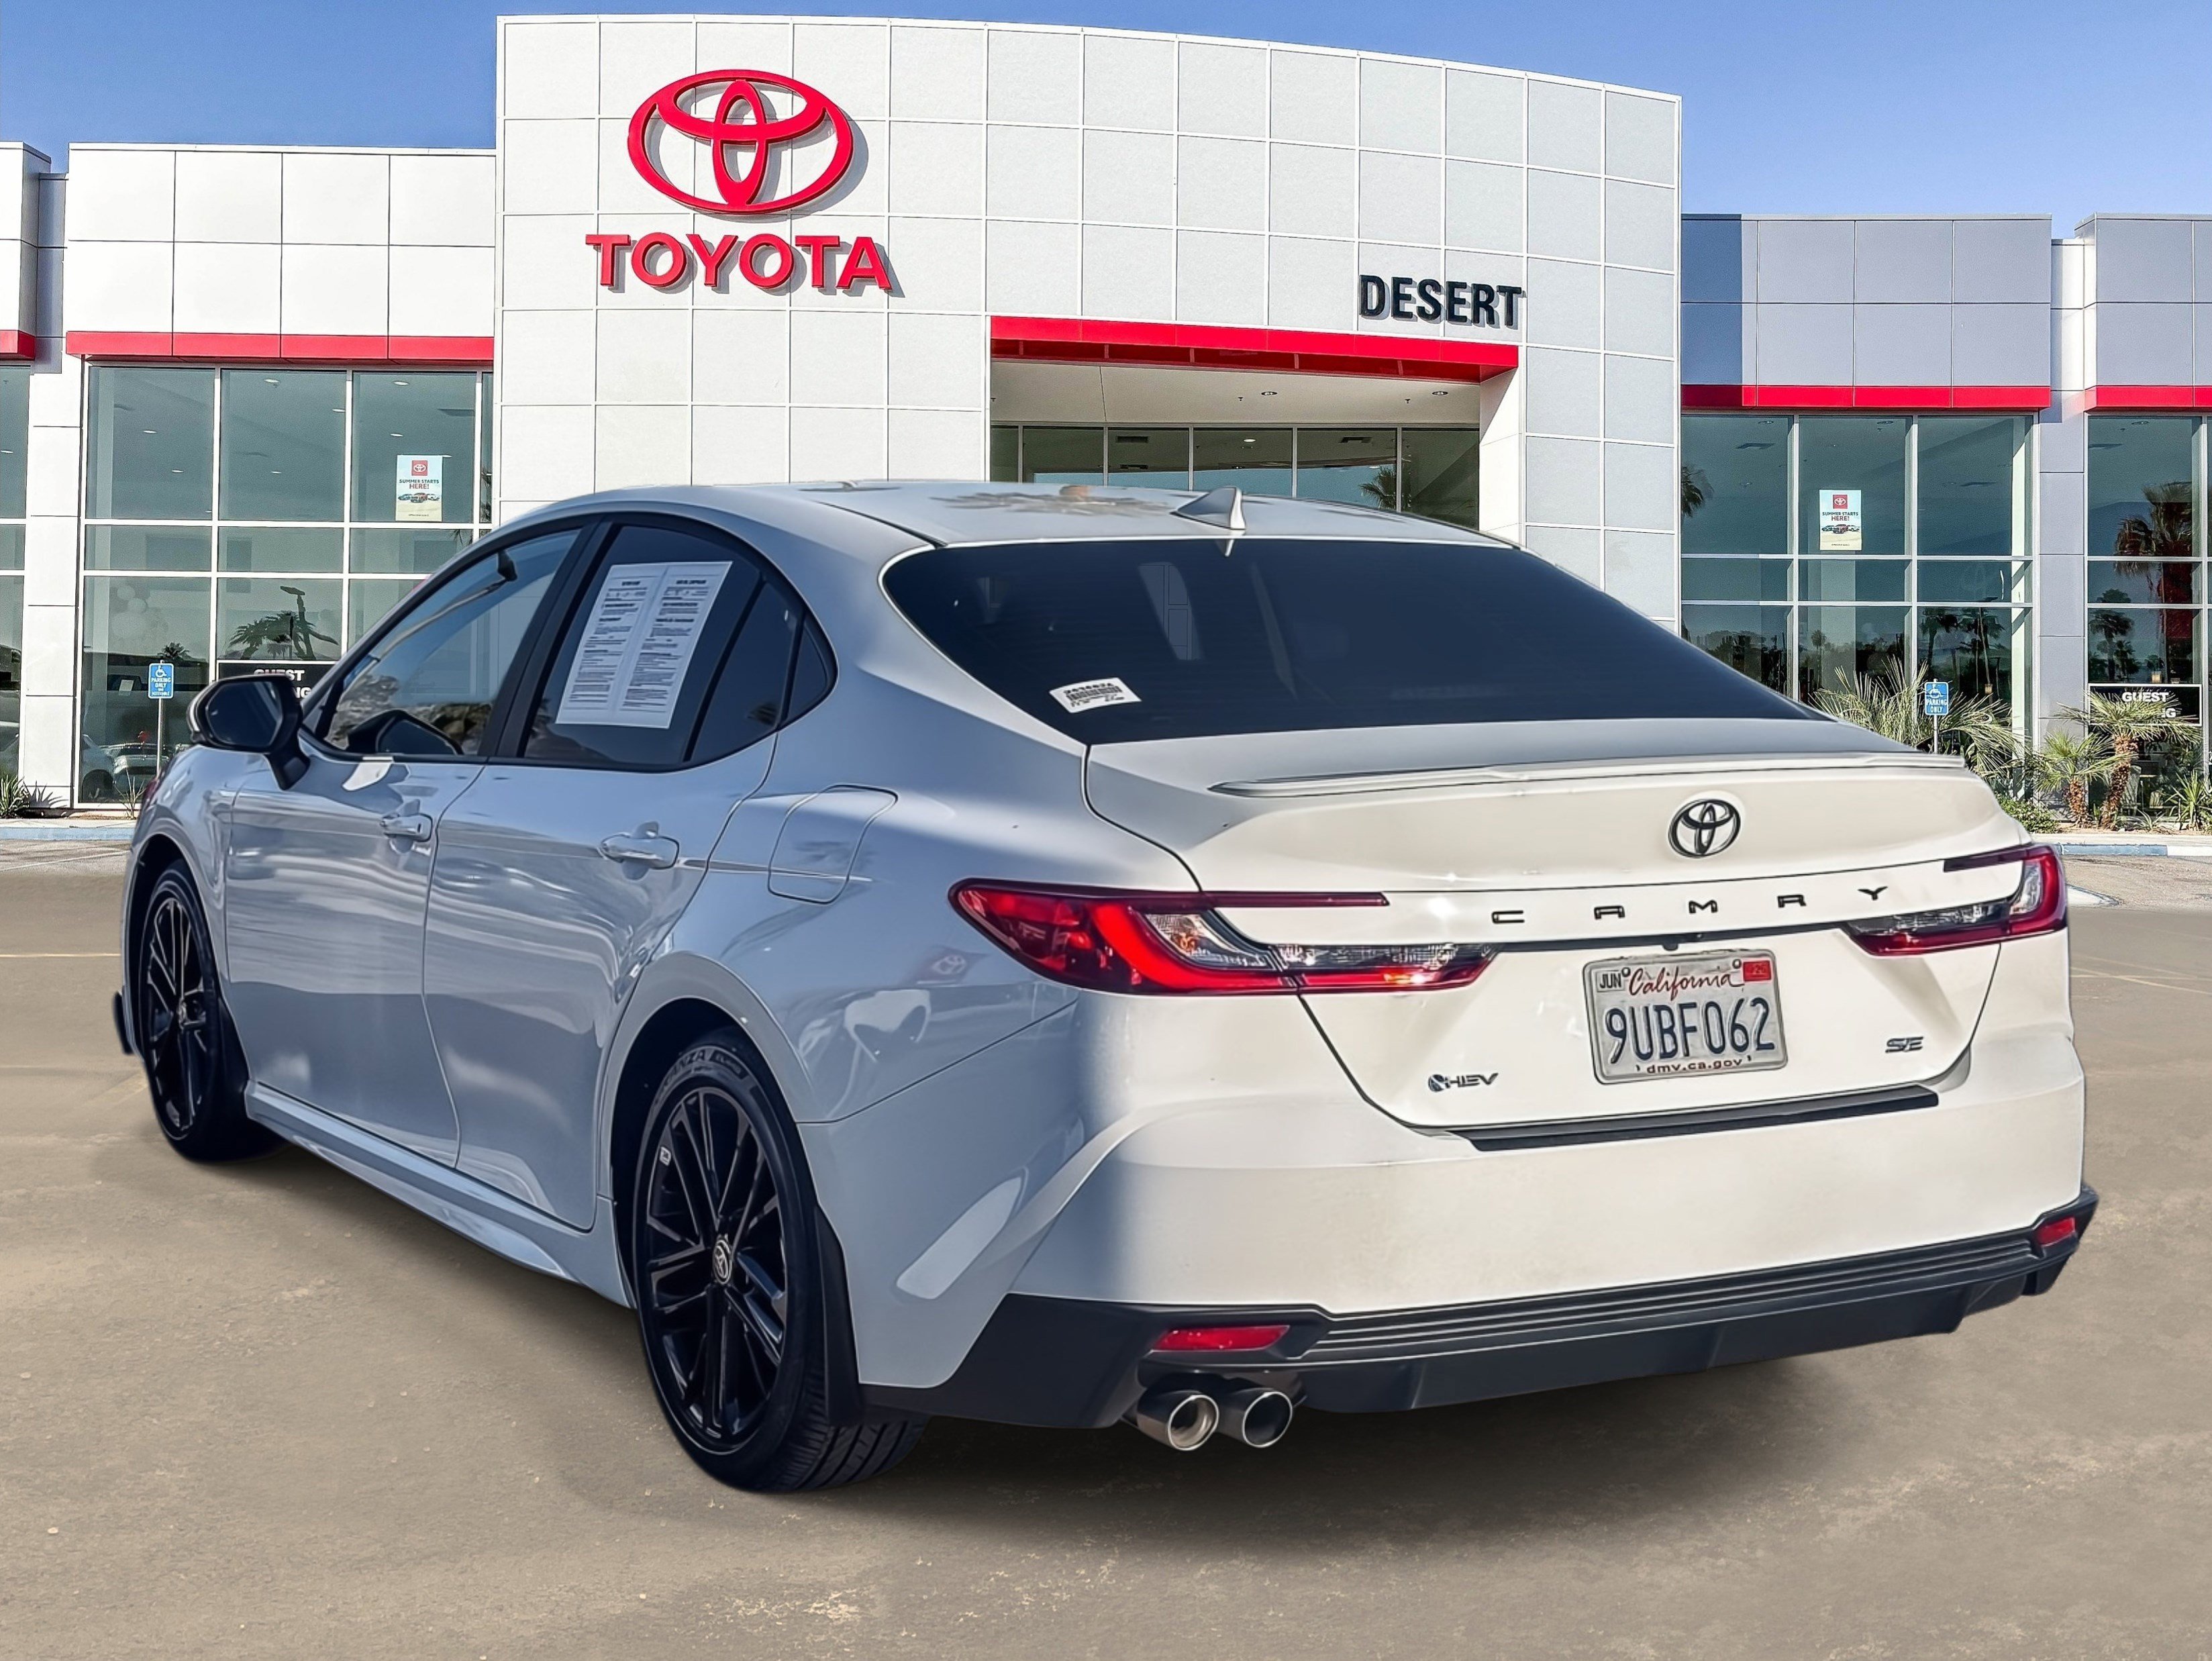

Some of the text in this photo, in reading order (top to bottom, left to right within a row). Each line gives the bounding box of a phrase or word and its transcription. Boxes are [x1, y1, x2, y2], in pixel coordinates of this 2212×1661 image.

[585, 232, 892, 290] TOYOTA
[1359, 274, 1522, 327] DESERT
[1492, 886, 1888, 924] CAMRY
[1600, 973, 1621, 989] JUN
[1629, 966, 1745, 1001] California
[1605, 997, 1775, 1064] 9UBF062
[1885, 1036, 1924, 1053] SE
[1647, 1058, 1742, 1073] dmv.ca.gov
